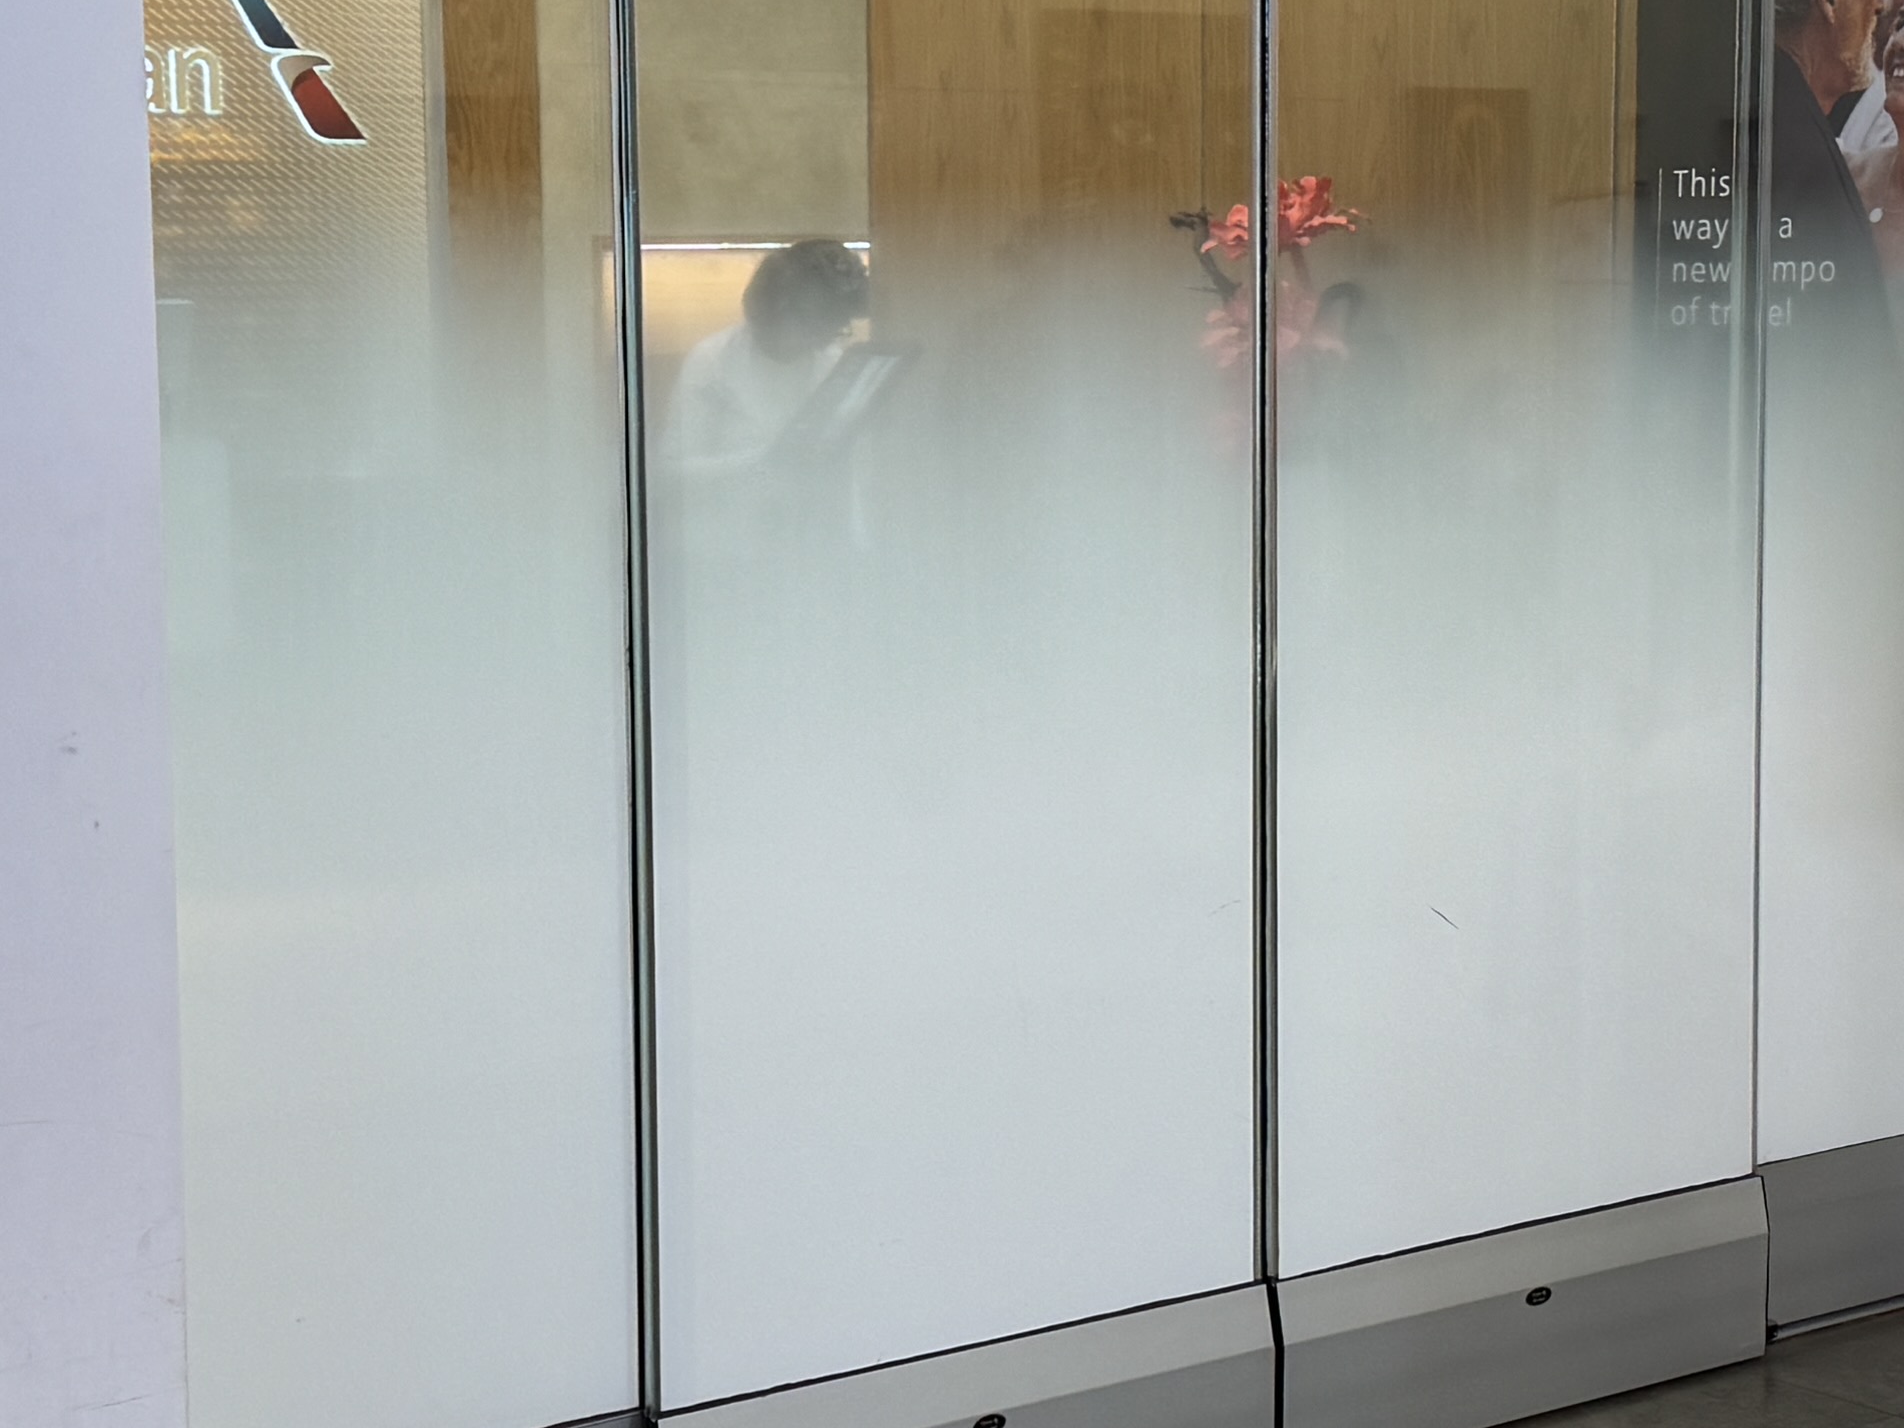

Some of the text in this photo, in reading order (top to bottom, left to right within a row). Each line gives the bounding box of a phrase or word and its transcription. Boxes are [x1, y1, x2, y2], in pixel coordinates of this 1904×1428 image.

[1673, 167, 1730, 198] This
[1672, 217, 1792, 249] way a
[1672, 260, 1836, 291] new mpo
[1671, 296, 1792, 326] of trel
